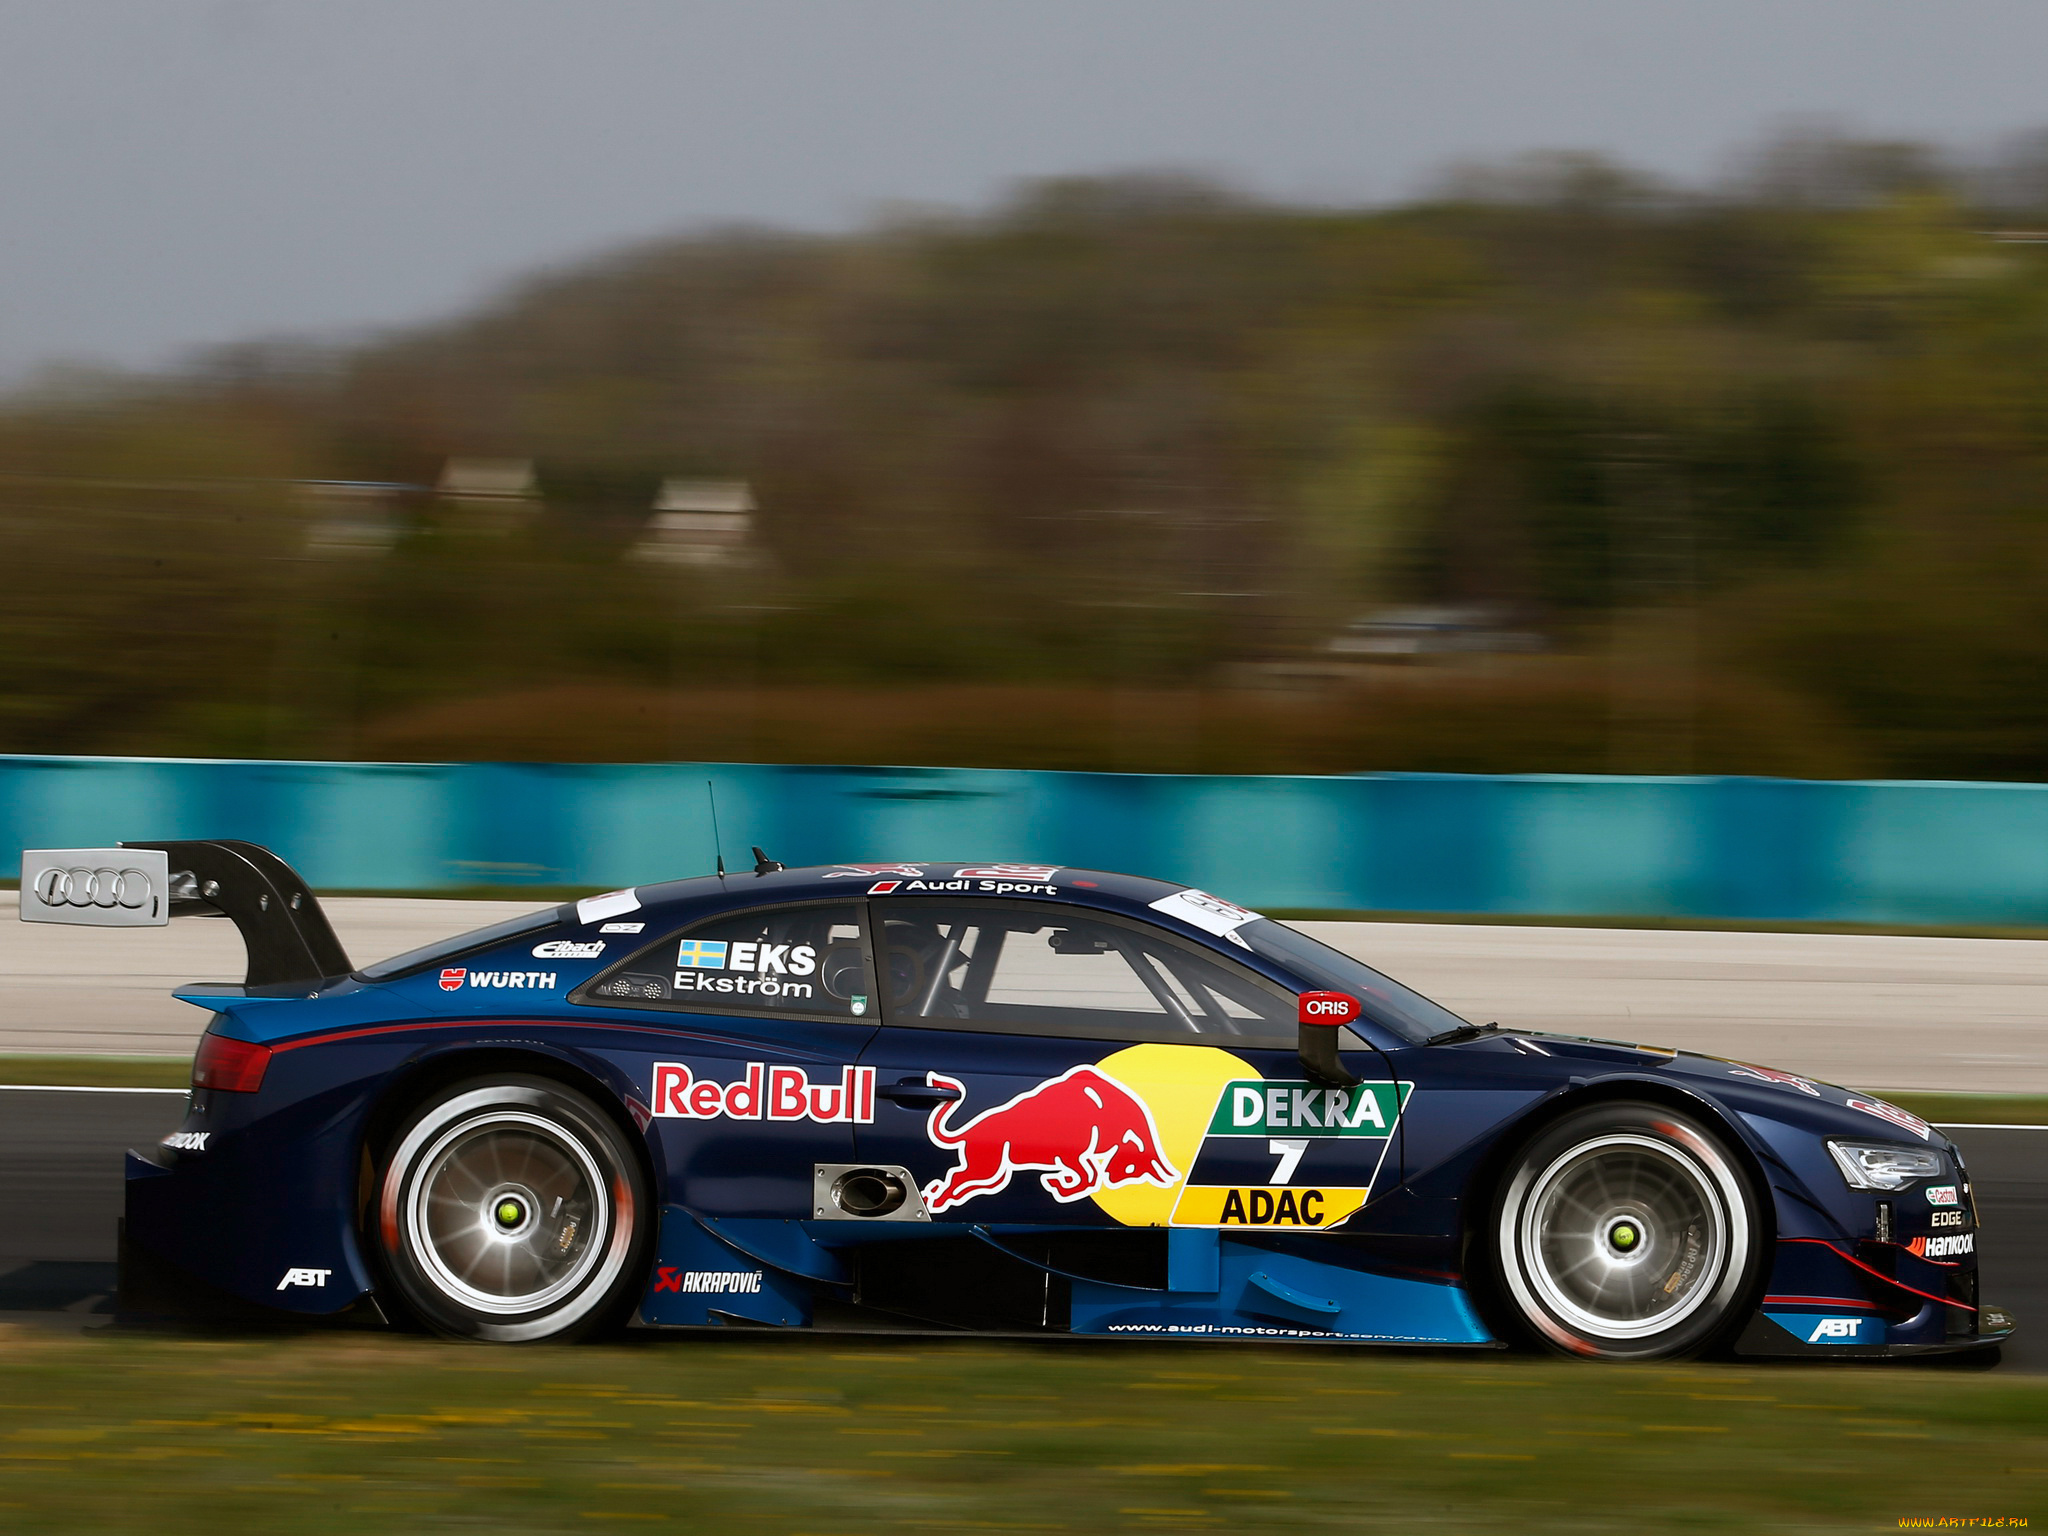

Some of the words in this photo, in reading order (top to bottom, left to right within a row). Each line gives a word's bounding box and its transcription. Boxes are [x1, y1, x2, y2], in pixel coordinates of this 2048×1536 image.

[906, 880, 970, 891] Audi
[979, 881, 1058, 895] Sport
[532, 939, 607, 958] Eibach
[729, 941, 817, 976] EKS
[469, 971, 557, 989] WÜRTH
[674, 970, 813, 998] Ekström
[1306, 1000, 1349, 1015] ORIS
[652, 1062, 765, 1120] Red
[767, 1064, 876, 1124] Bull
[1232, 1087, 1386, 1128] DEKRA
[1269, 1139, 1310, 1185] 7
[1935, 1188, 1958, 1203] Castrol
[1219, 1189, 1325, 1226] ADAC
[1931, 1211, 1962, 1227] EDGE
[276, 1268, 332, 1290] ABT
[682, 1270, 763, 1293] AKRAPOVIČ
[1807, 1318, 1862, 1342] ABT
